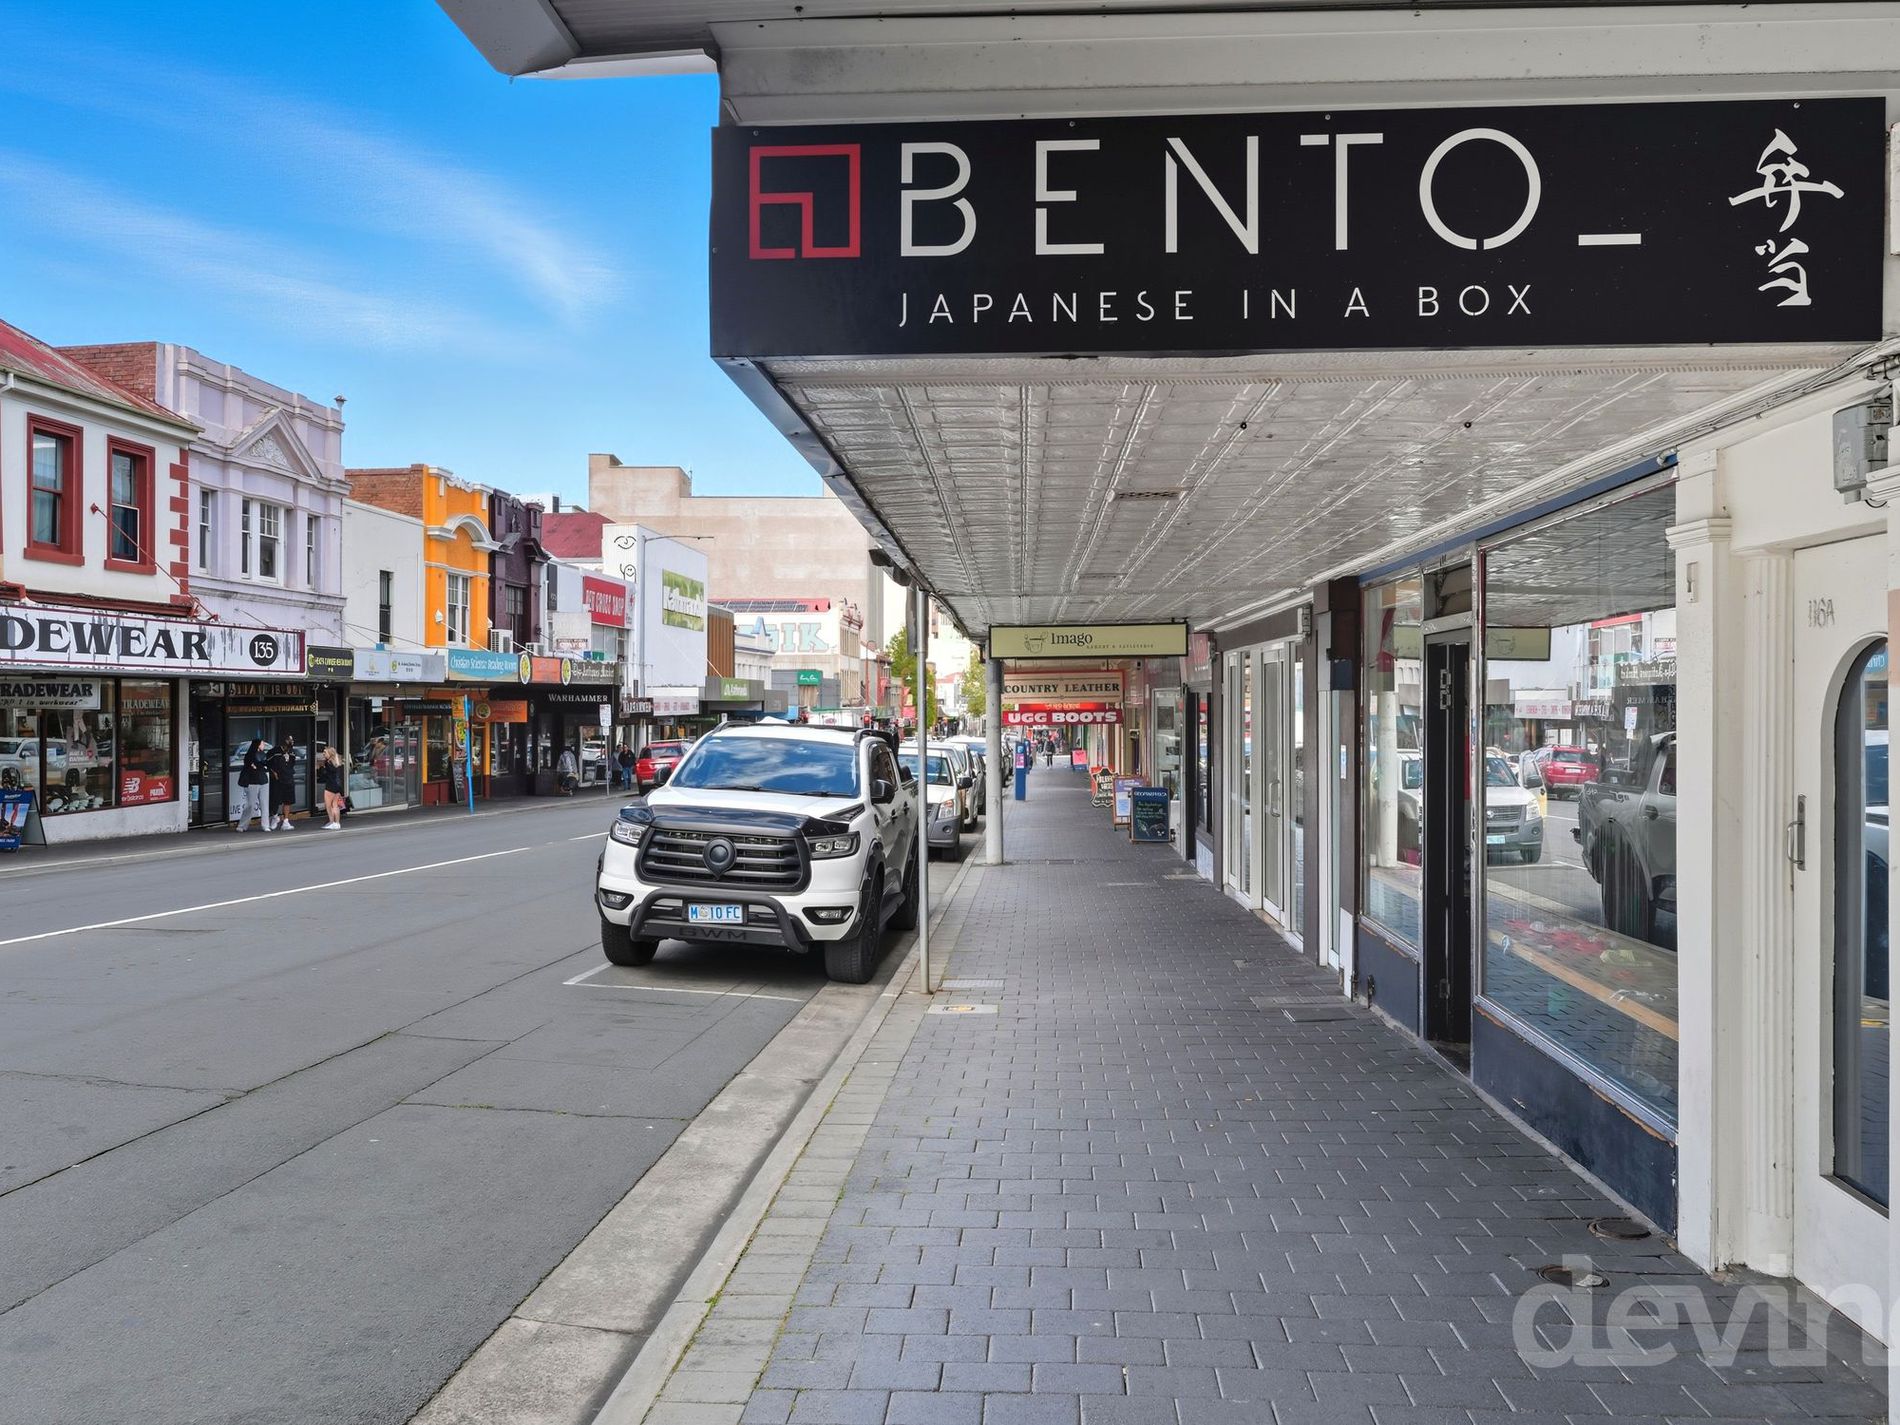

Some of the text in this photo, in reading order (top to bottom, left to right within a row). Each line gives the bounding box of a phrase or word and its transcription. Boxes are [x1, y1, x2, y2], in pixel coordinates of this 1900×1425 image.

[899, 283, 1531, 327] JAPANESE IN A BOX
[1051, 632, 1093, 647] Imago
[254, 641, 274, 659] 135
[0, 683, 93, 697] RADEWEAR
[1004, 682, 1119, 693] COUNTRY LEATHER
[548, 693, 608, 702] WARHAMMER
[1008, 711, 1117, 723] UGG BOOTS
[690, 906, 698, 919] M
